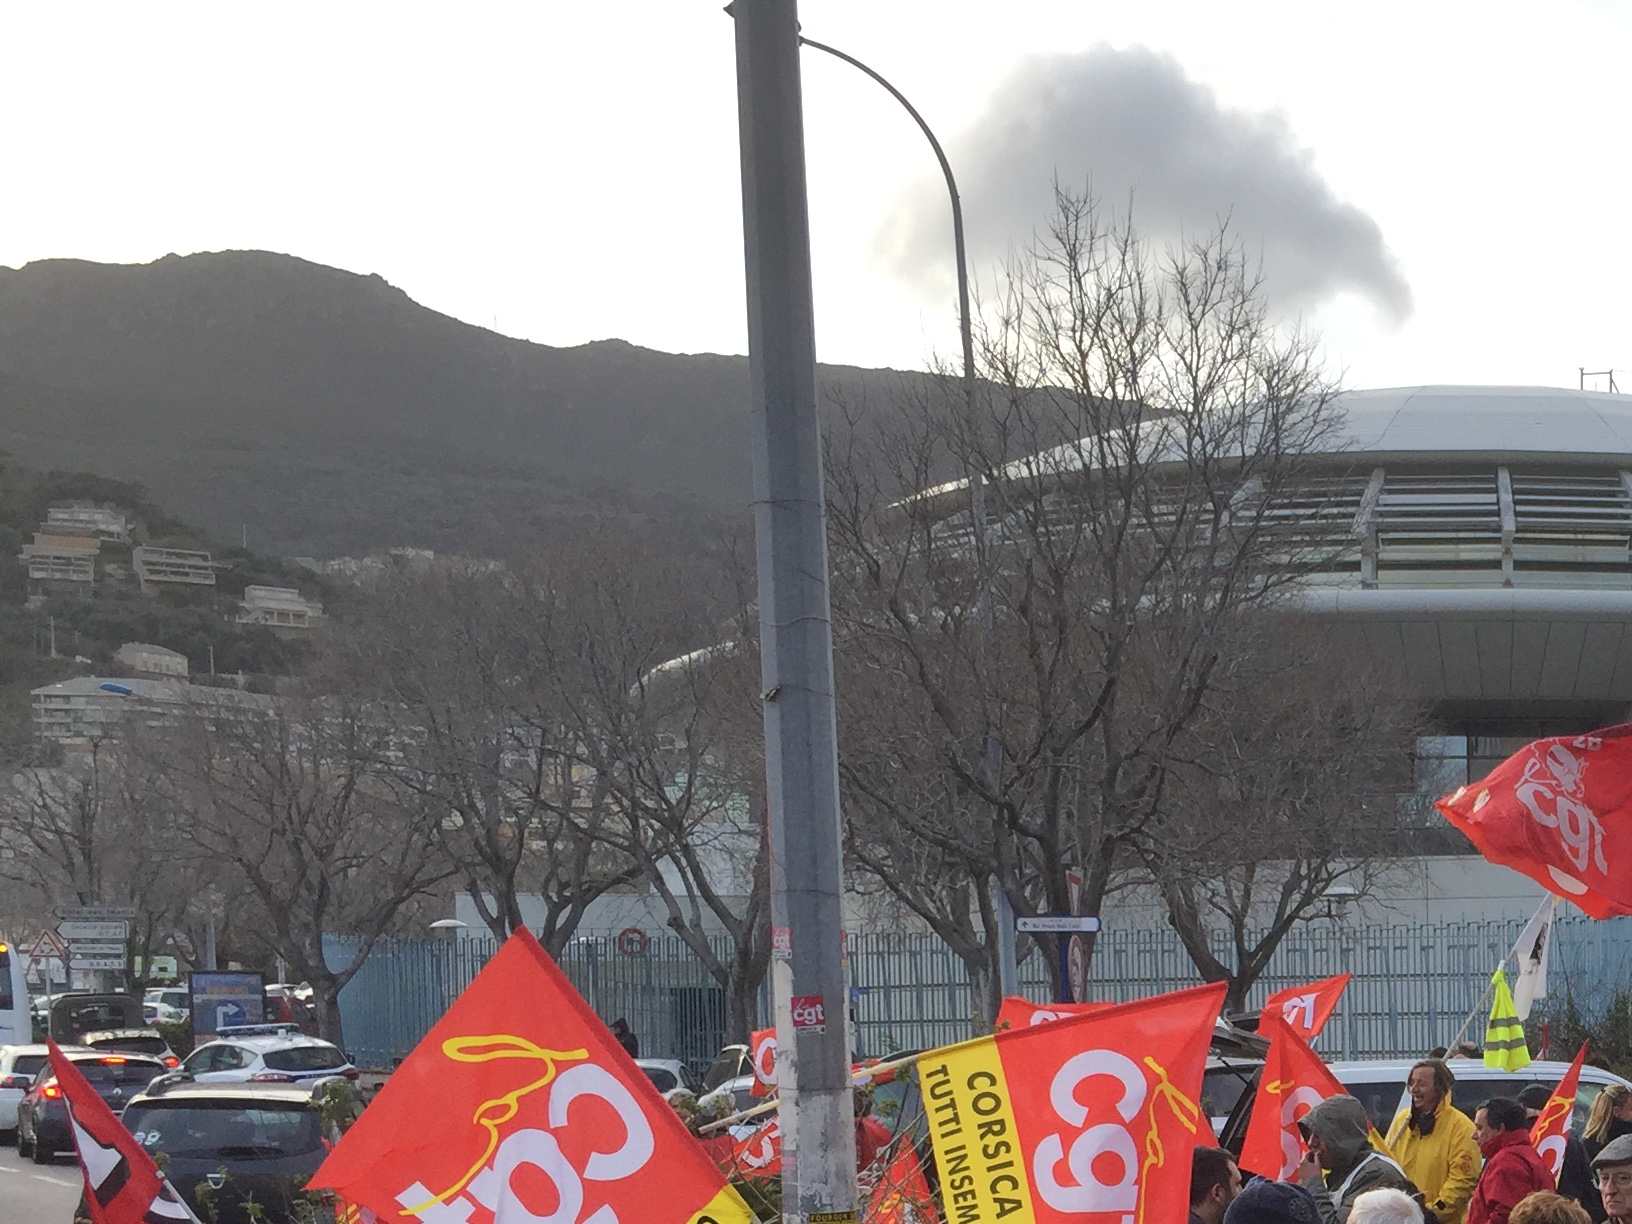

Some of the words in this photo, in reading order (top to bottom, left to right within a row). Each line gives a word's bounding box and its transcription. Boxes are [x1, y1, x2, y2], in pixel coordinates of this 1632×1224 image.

[1516, 782, 1607, 876] cgt
[793, 1004, 825, 1025] cgt
[925, 1064, 962, 1139] TUTTI
[967, 1071, 1024, 1220] CORSICA
